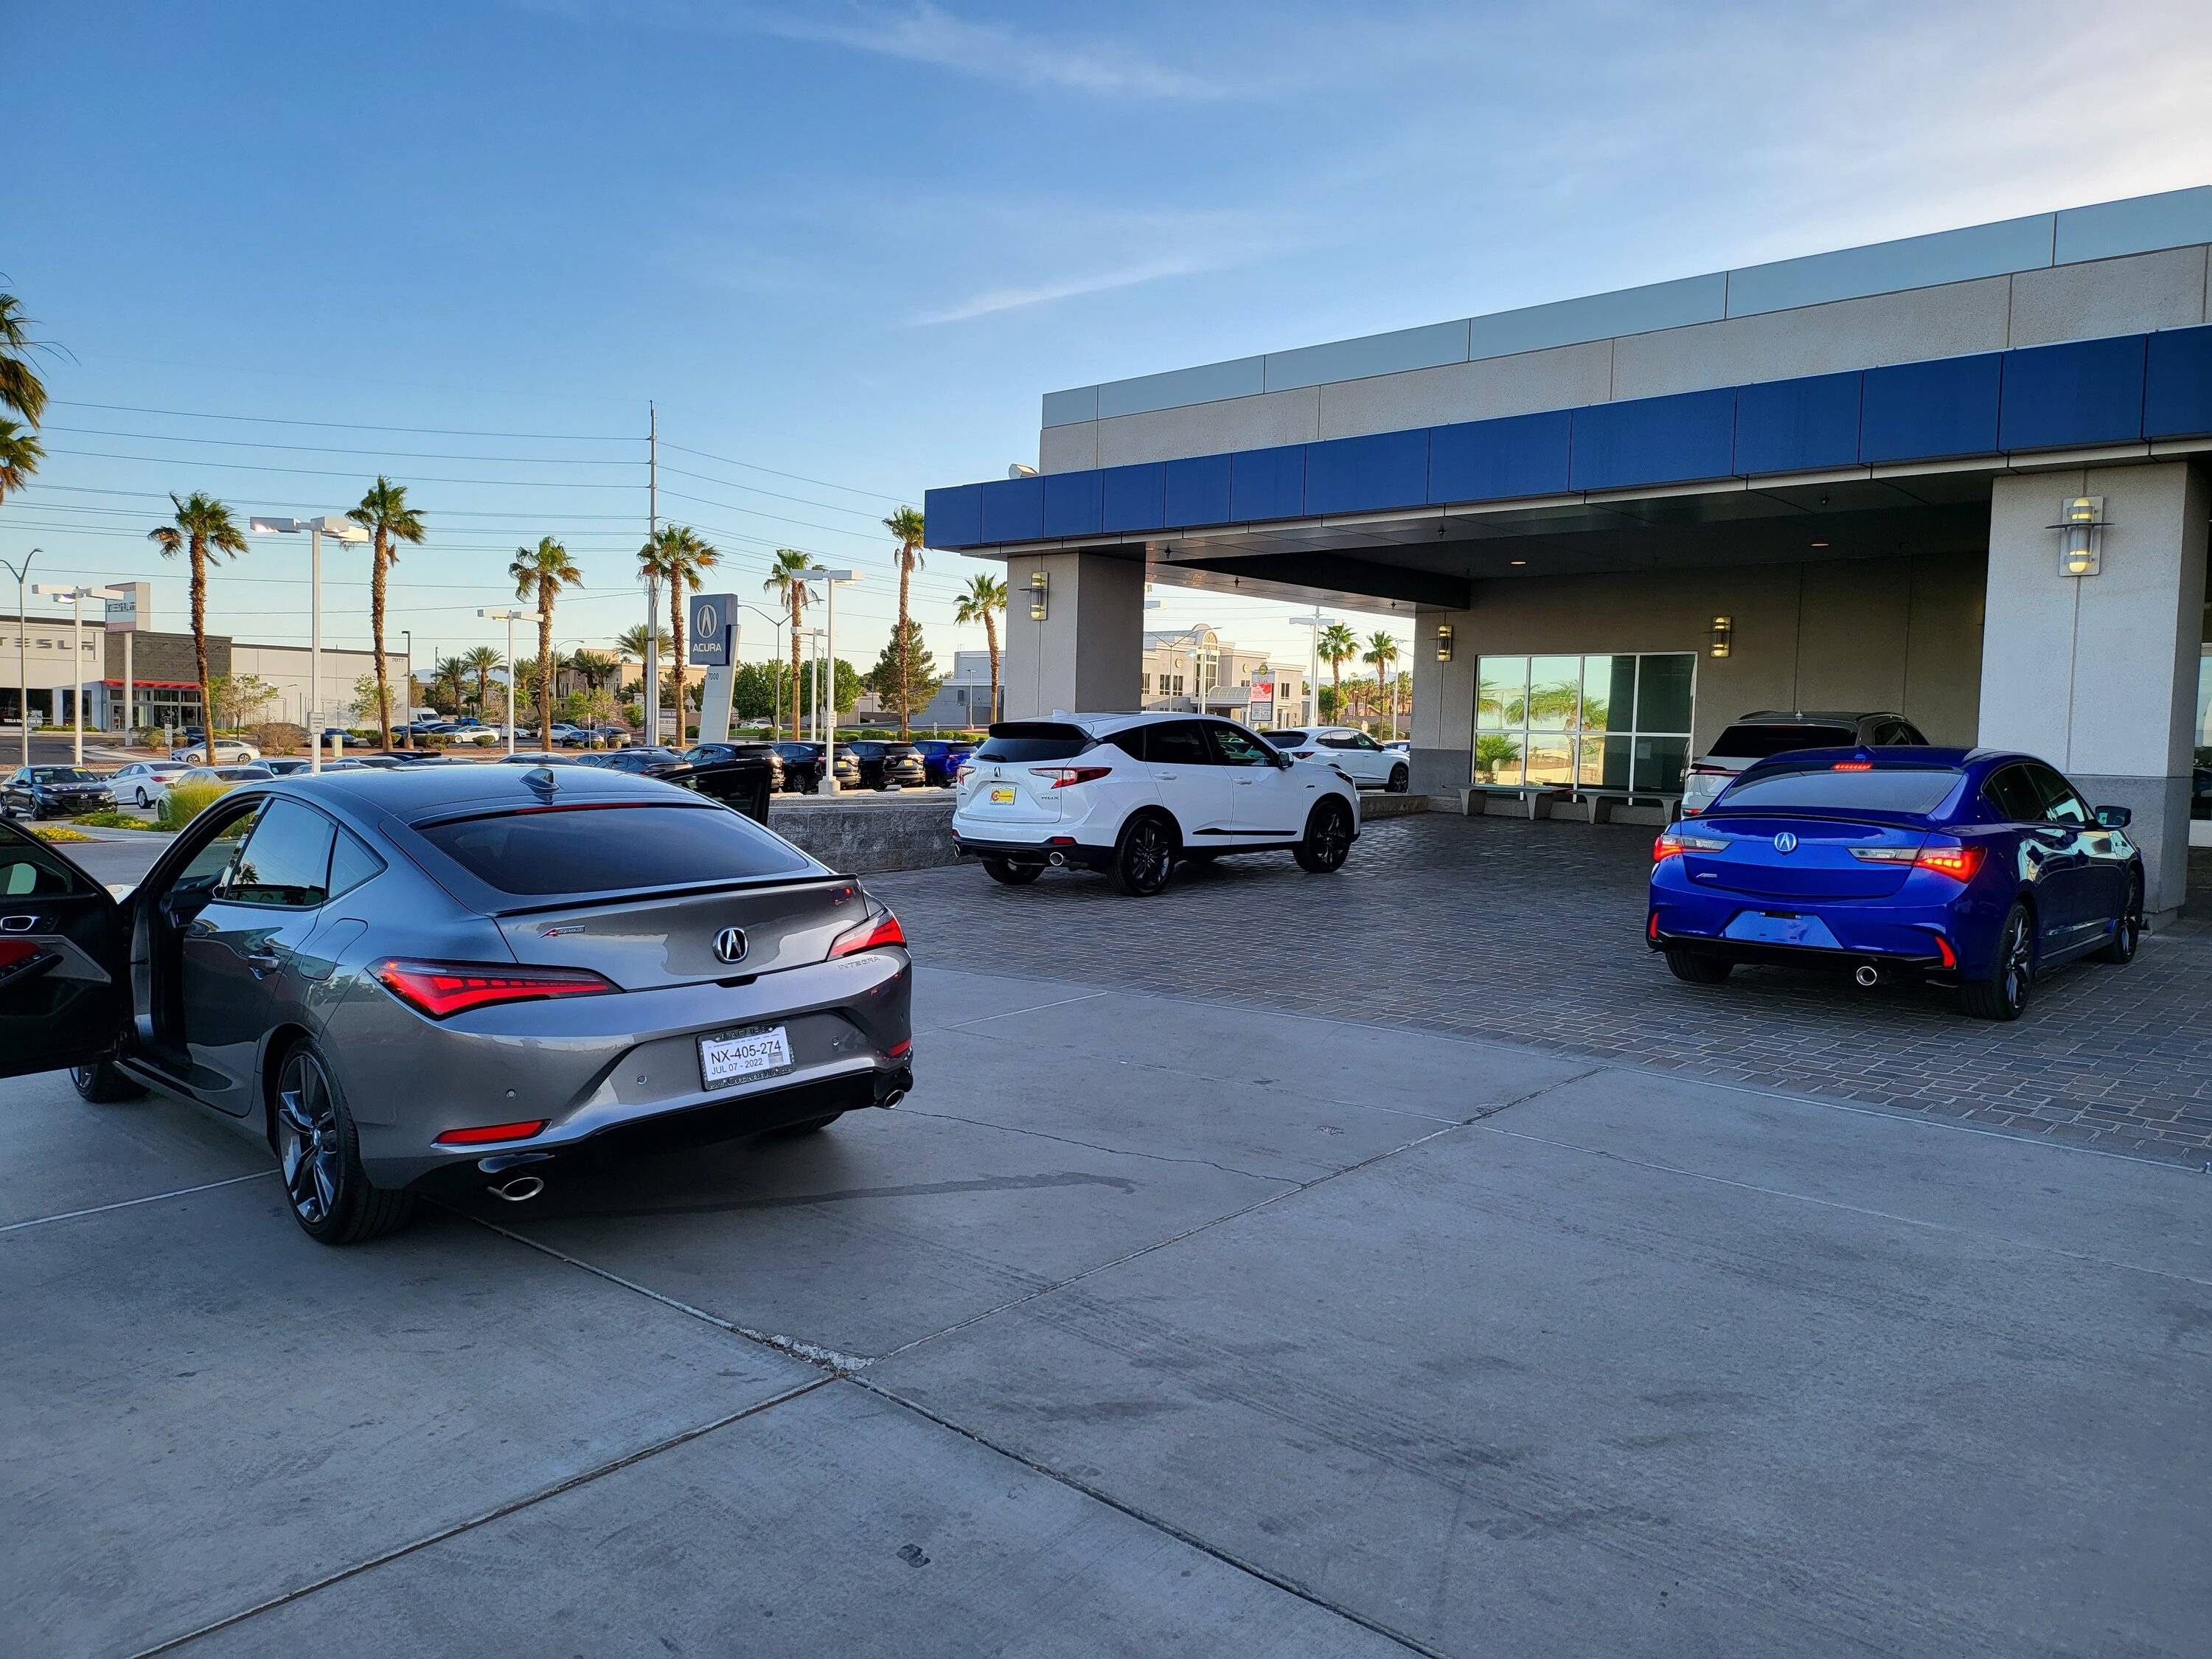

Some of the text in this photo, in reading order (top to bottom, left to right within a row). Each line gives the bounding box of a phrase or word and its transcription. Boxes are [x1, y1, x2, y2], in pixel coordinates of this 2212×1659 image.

[692, 643, 722, 653] ACURA
[838, 956, 880, 970] INTEGRA
[711, 1040, 782, 1064] NX-405-274
[712, 1065, 727, 1075] JUL
[728, 1063, 737, 1071] 07
[745, 1057, 763, 1068] 2022
